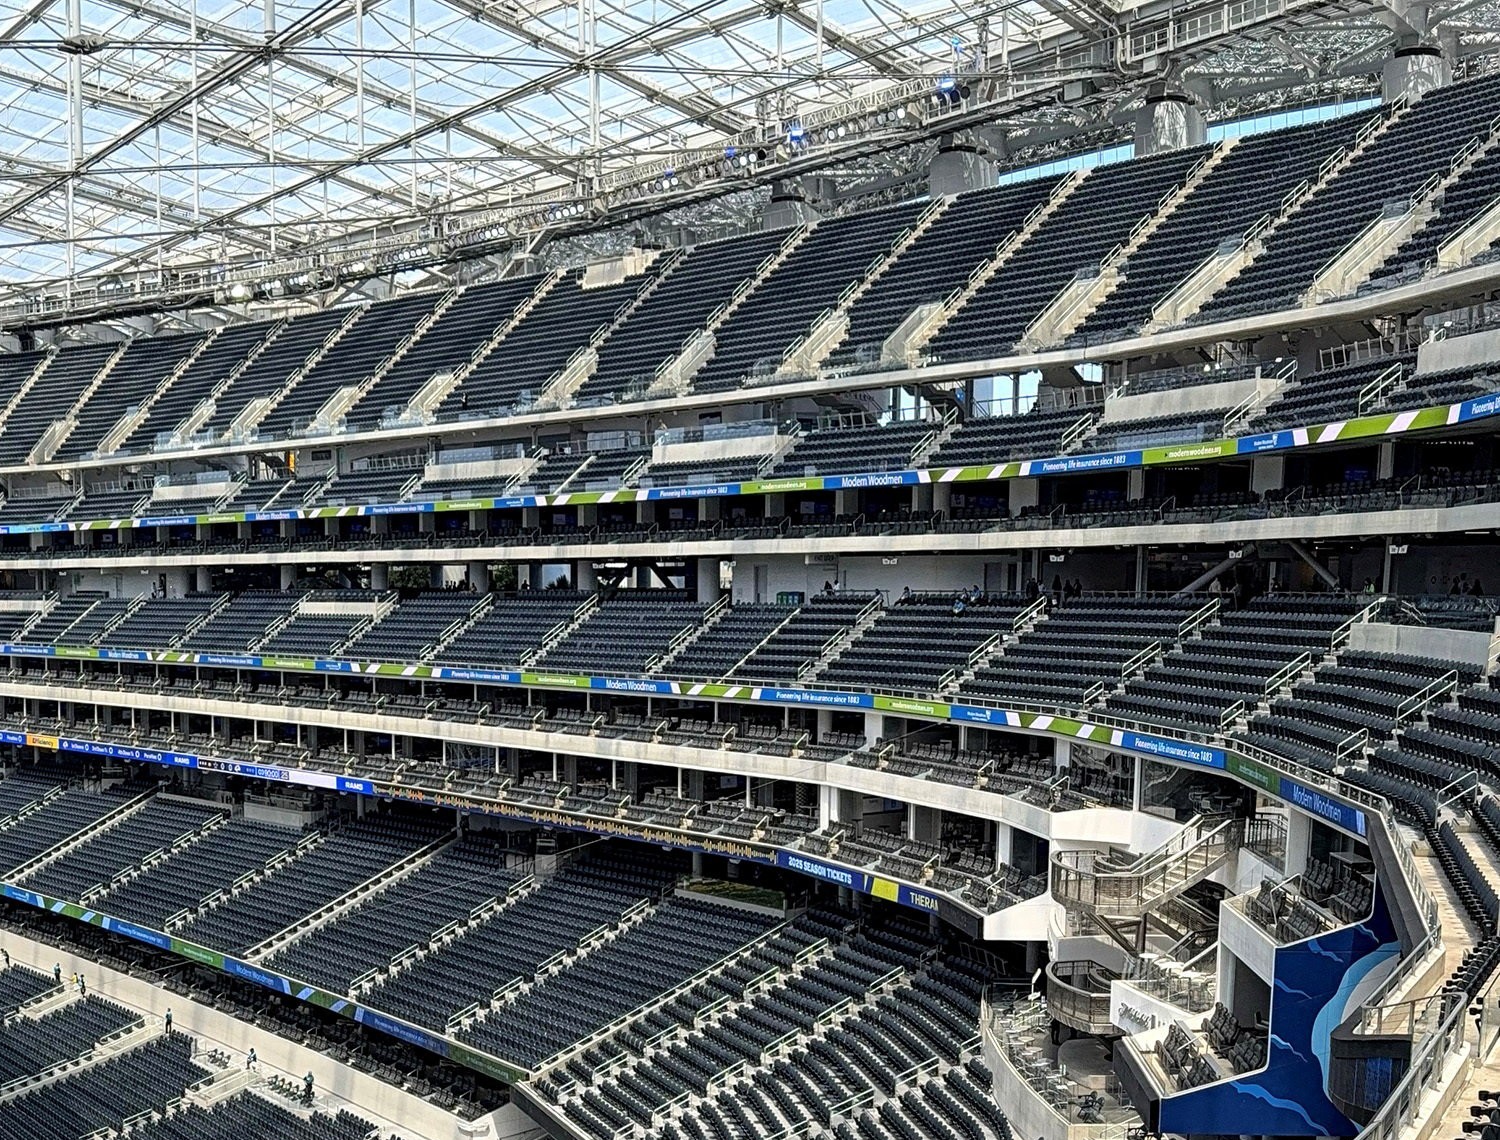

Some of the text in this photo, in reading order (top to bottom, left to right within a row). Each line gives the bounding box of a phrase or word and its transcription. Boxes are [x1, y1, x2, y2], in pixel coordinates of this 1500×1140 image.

[1043, 461, 1067, 471] Pioneering
[842, 474, 902, 487] Modern Woodmen
[1135, 738, 1158, 753] Pioneering
[1187, 748, 1200, 760] since
[1293, 785, 1342, 823] Modern Woodmen
[804, 860, 826, 876] SEASON
[826, 867, 852, 884] TICKETS
